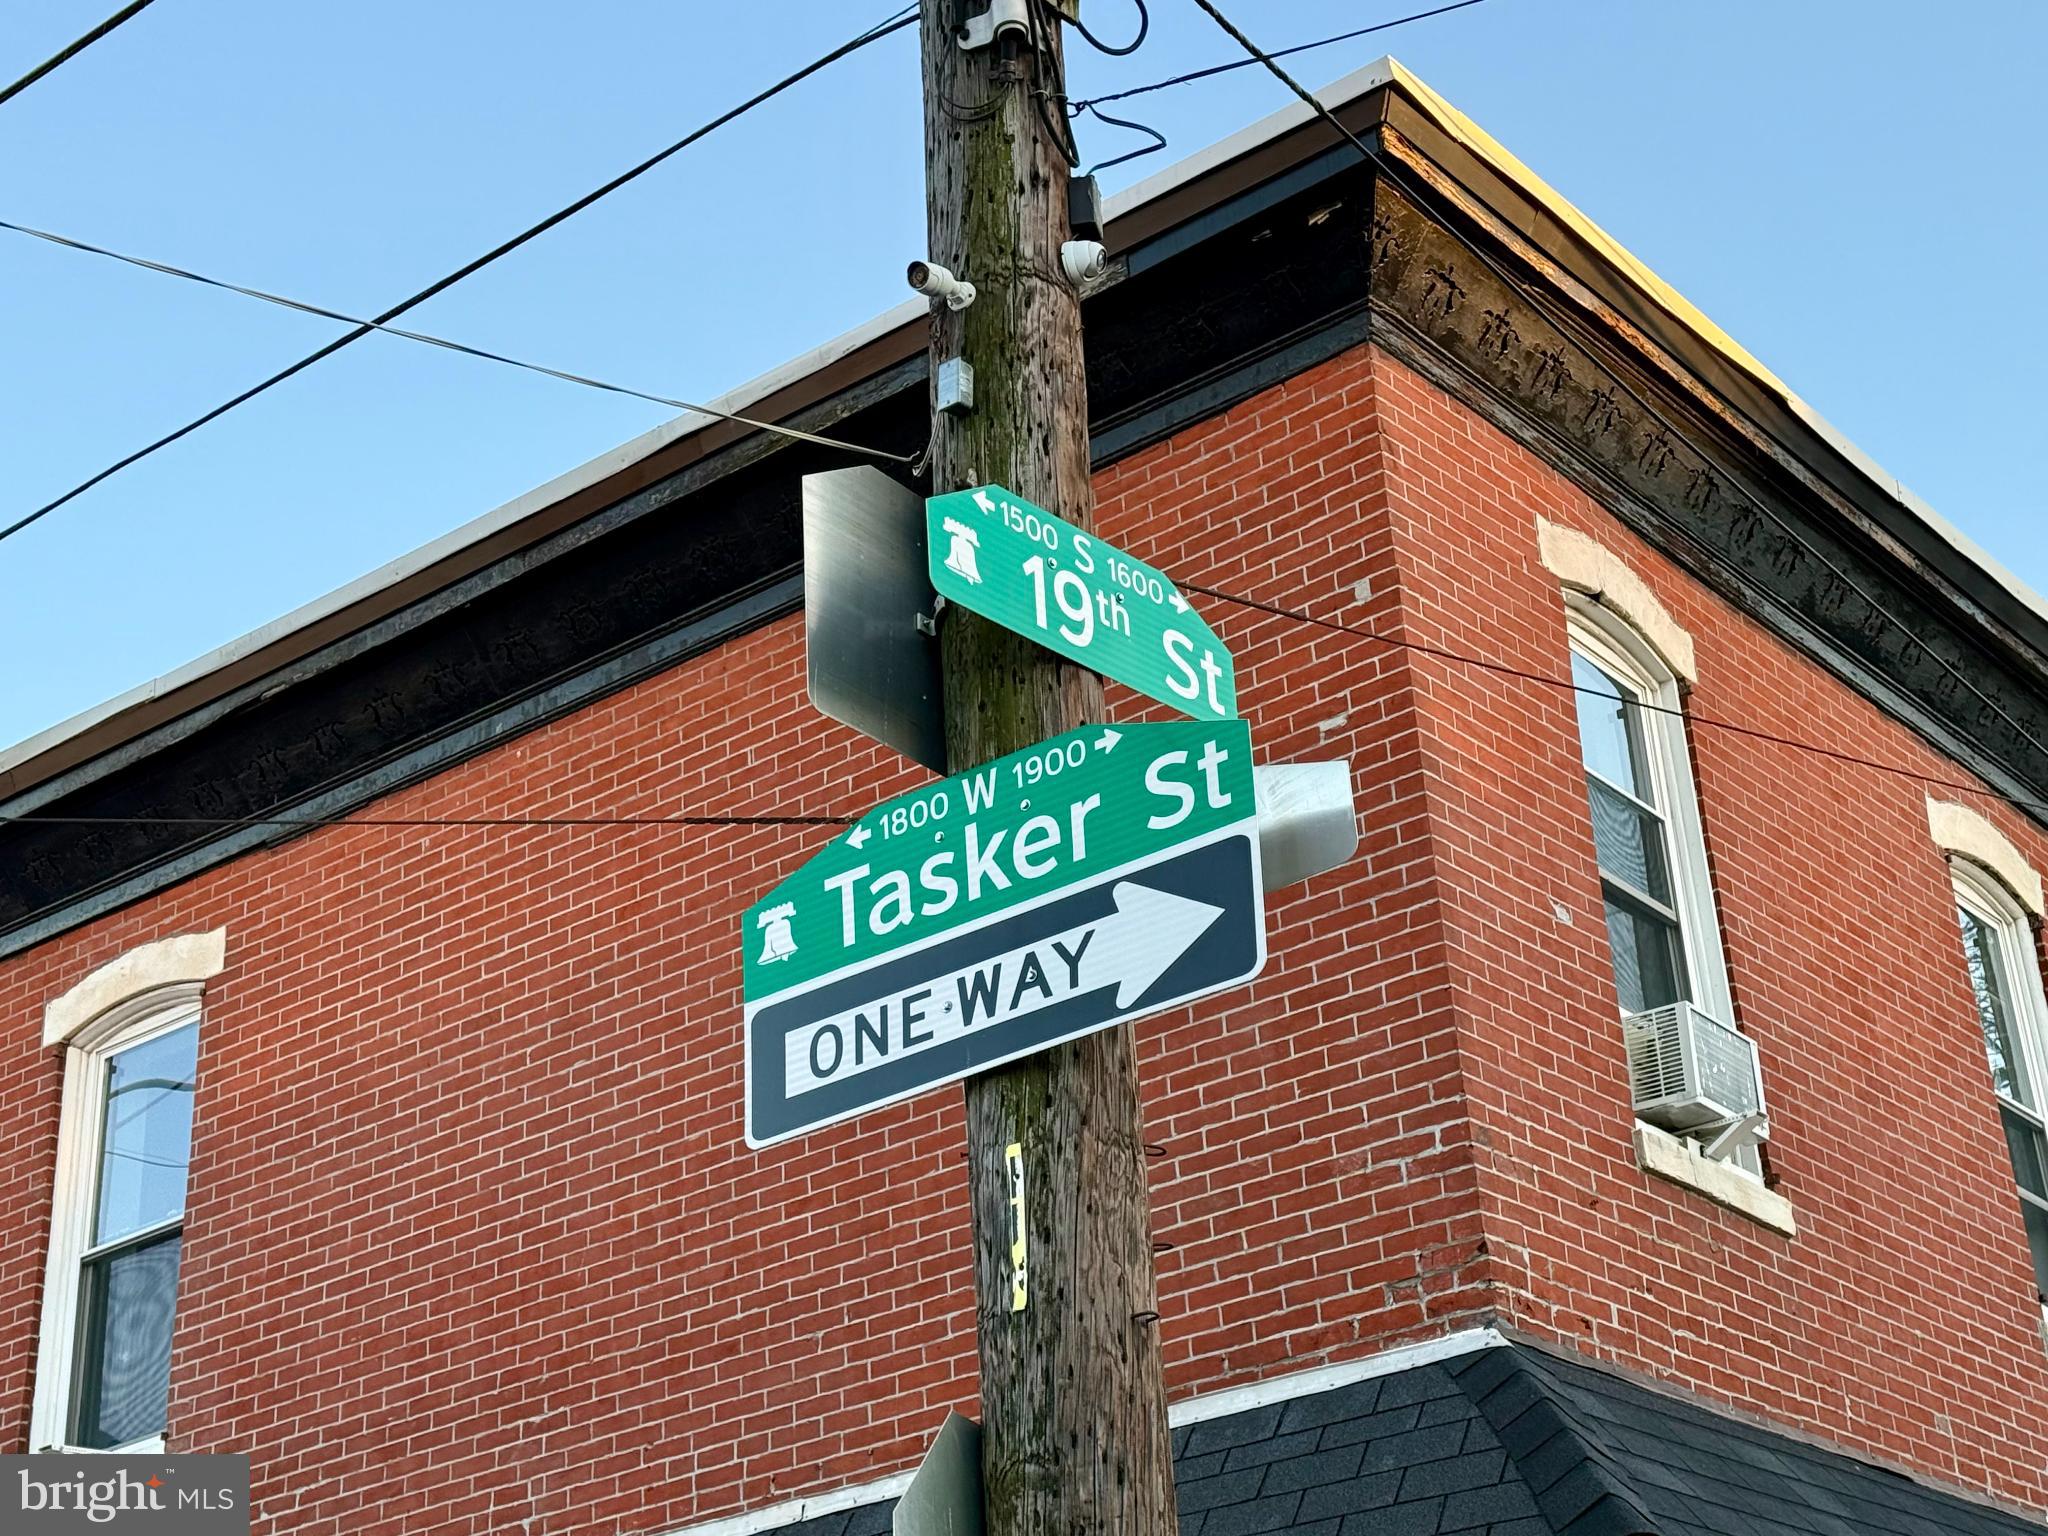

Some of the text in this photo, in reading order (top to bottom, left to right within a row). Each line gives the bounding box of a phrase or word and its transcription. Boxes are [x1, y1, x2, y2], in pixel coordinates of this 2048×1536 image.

[1000, 501, 1163, 605] 1500 S 1600
[1022, 555, 1225, 716] 19th St
[824, 740, 1232, 948] Tasker St
[879, 739, 1086, 839] 1800 W 1900
[809, 929, 1096, 1079] ONE WAY
